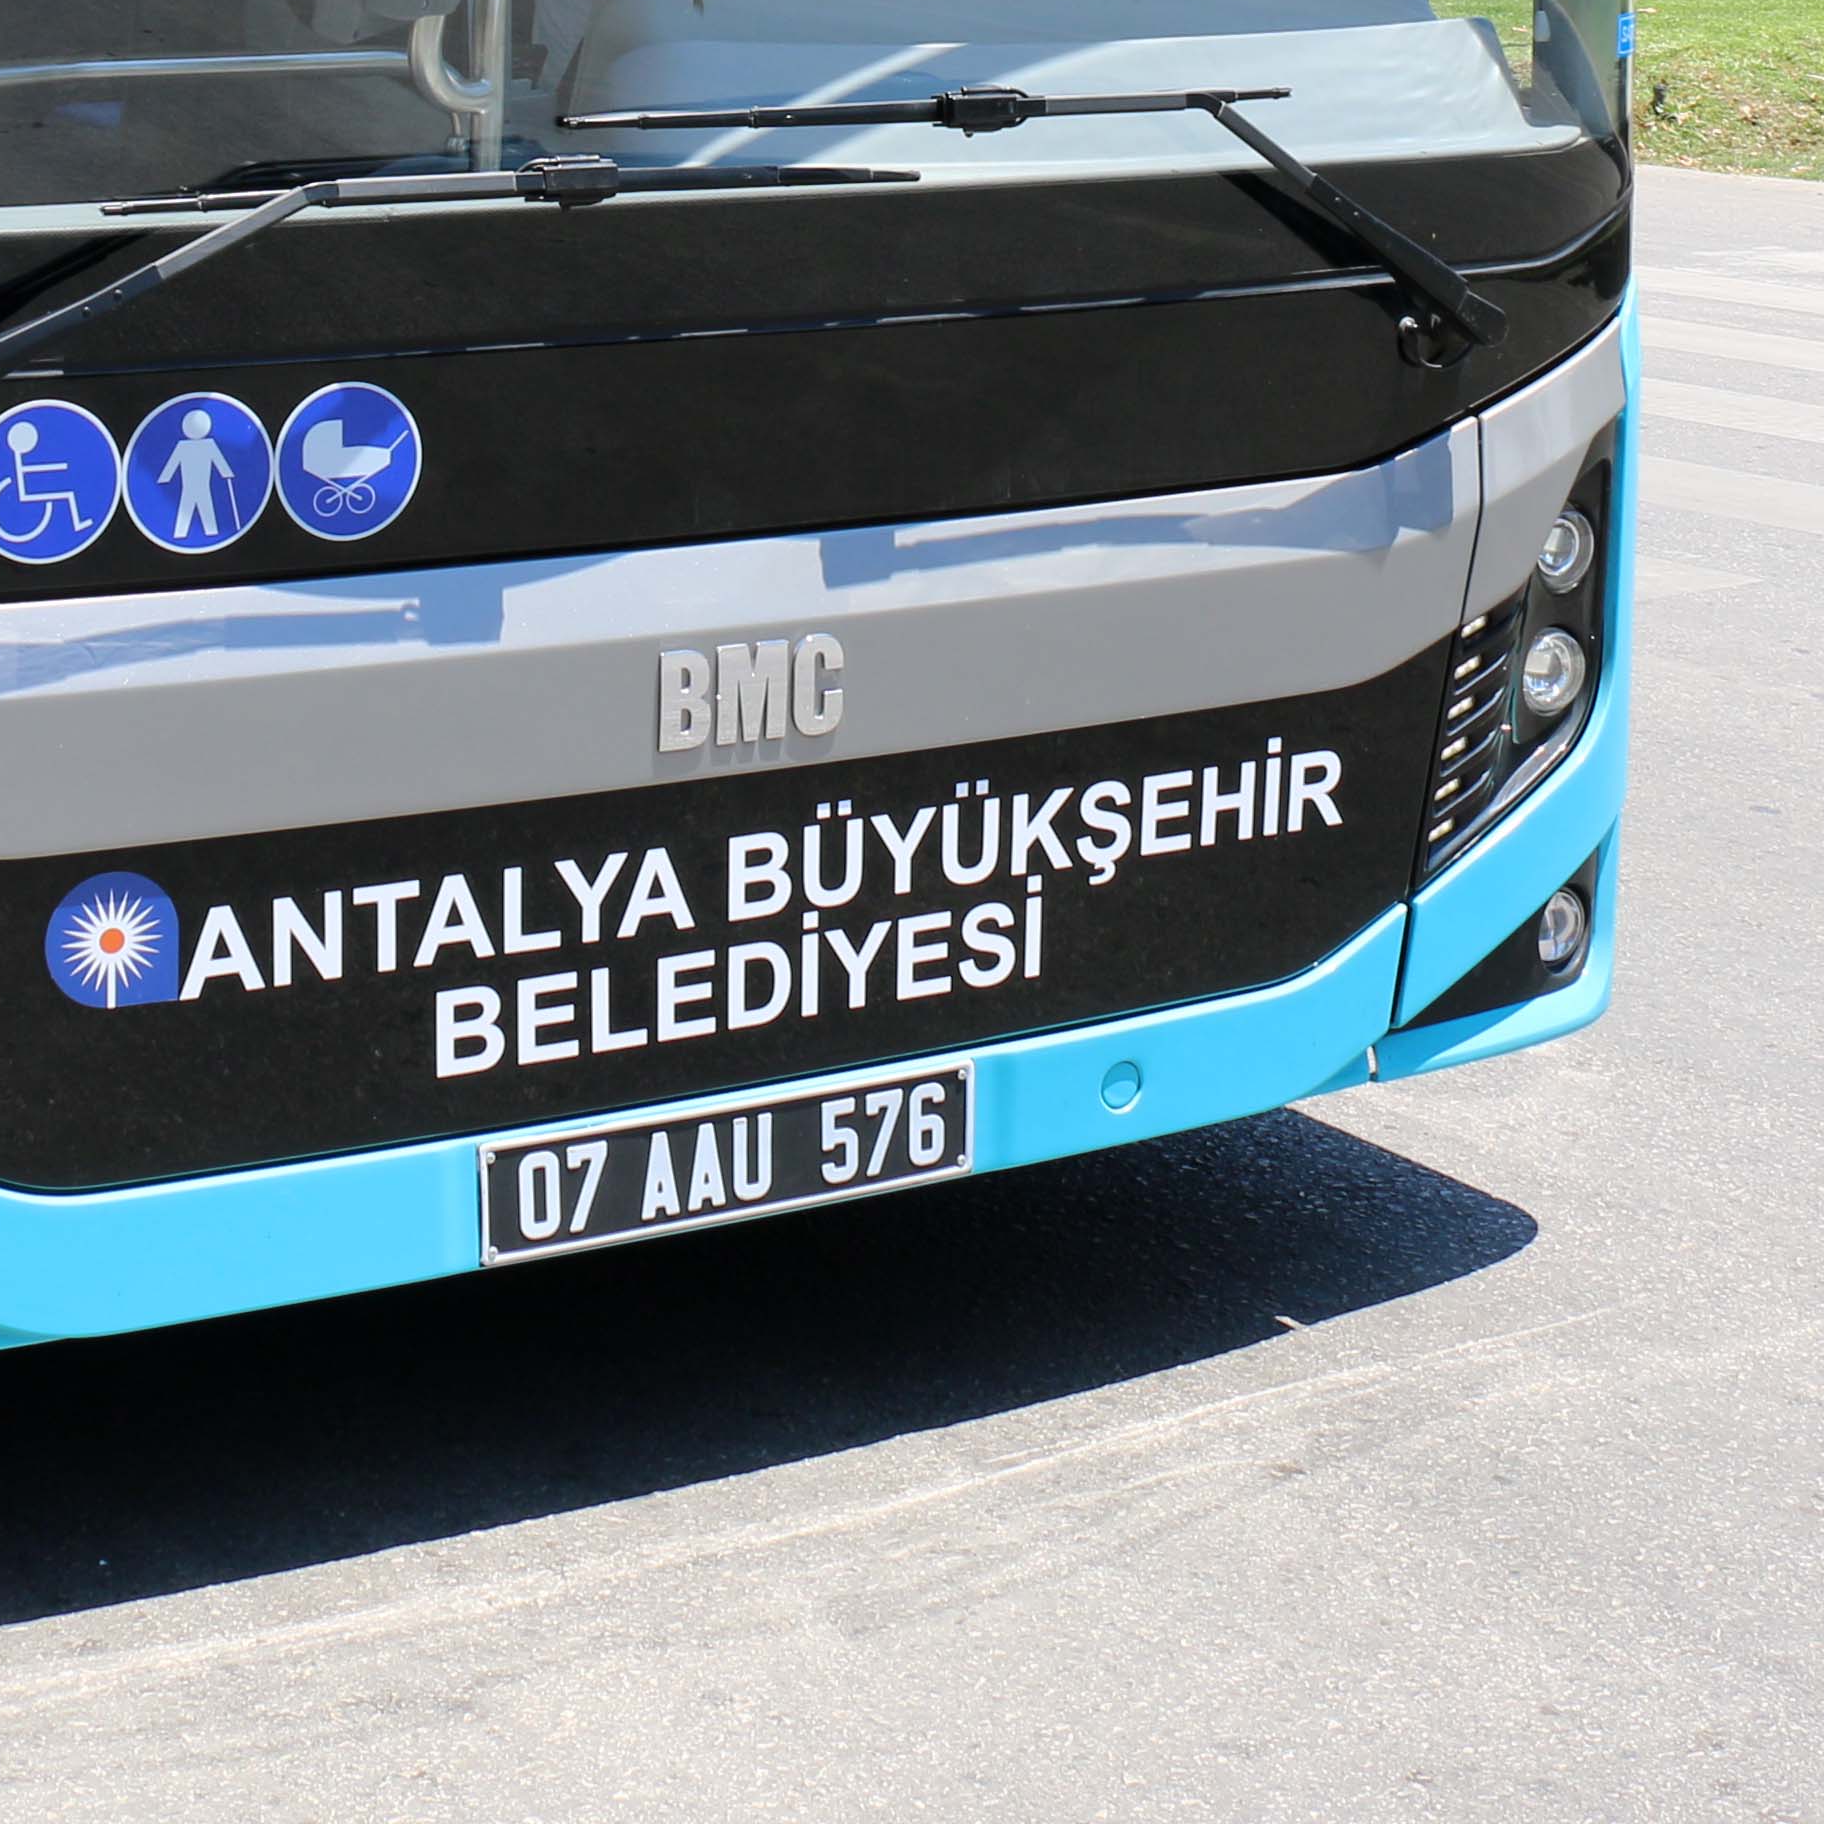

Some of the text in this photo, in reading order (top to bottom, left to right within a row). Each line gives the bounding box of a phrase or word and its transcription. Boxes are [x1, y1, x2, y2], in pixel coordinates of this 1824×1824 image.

[658, 633, 845, 753] BMC
[178, 736, 1344, 1002] ANTALYA BÜYÜKŞEHİR
[435, 874, 1043, 1079] BELEDİYESİ
[517, 1081, 947, 1242] 07 AAU 576
